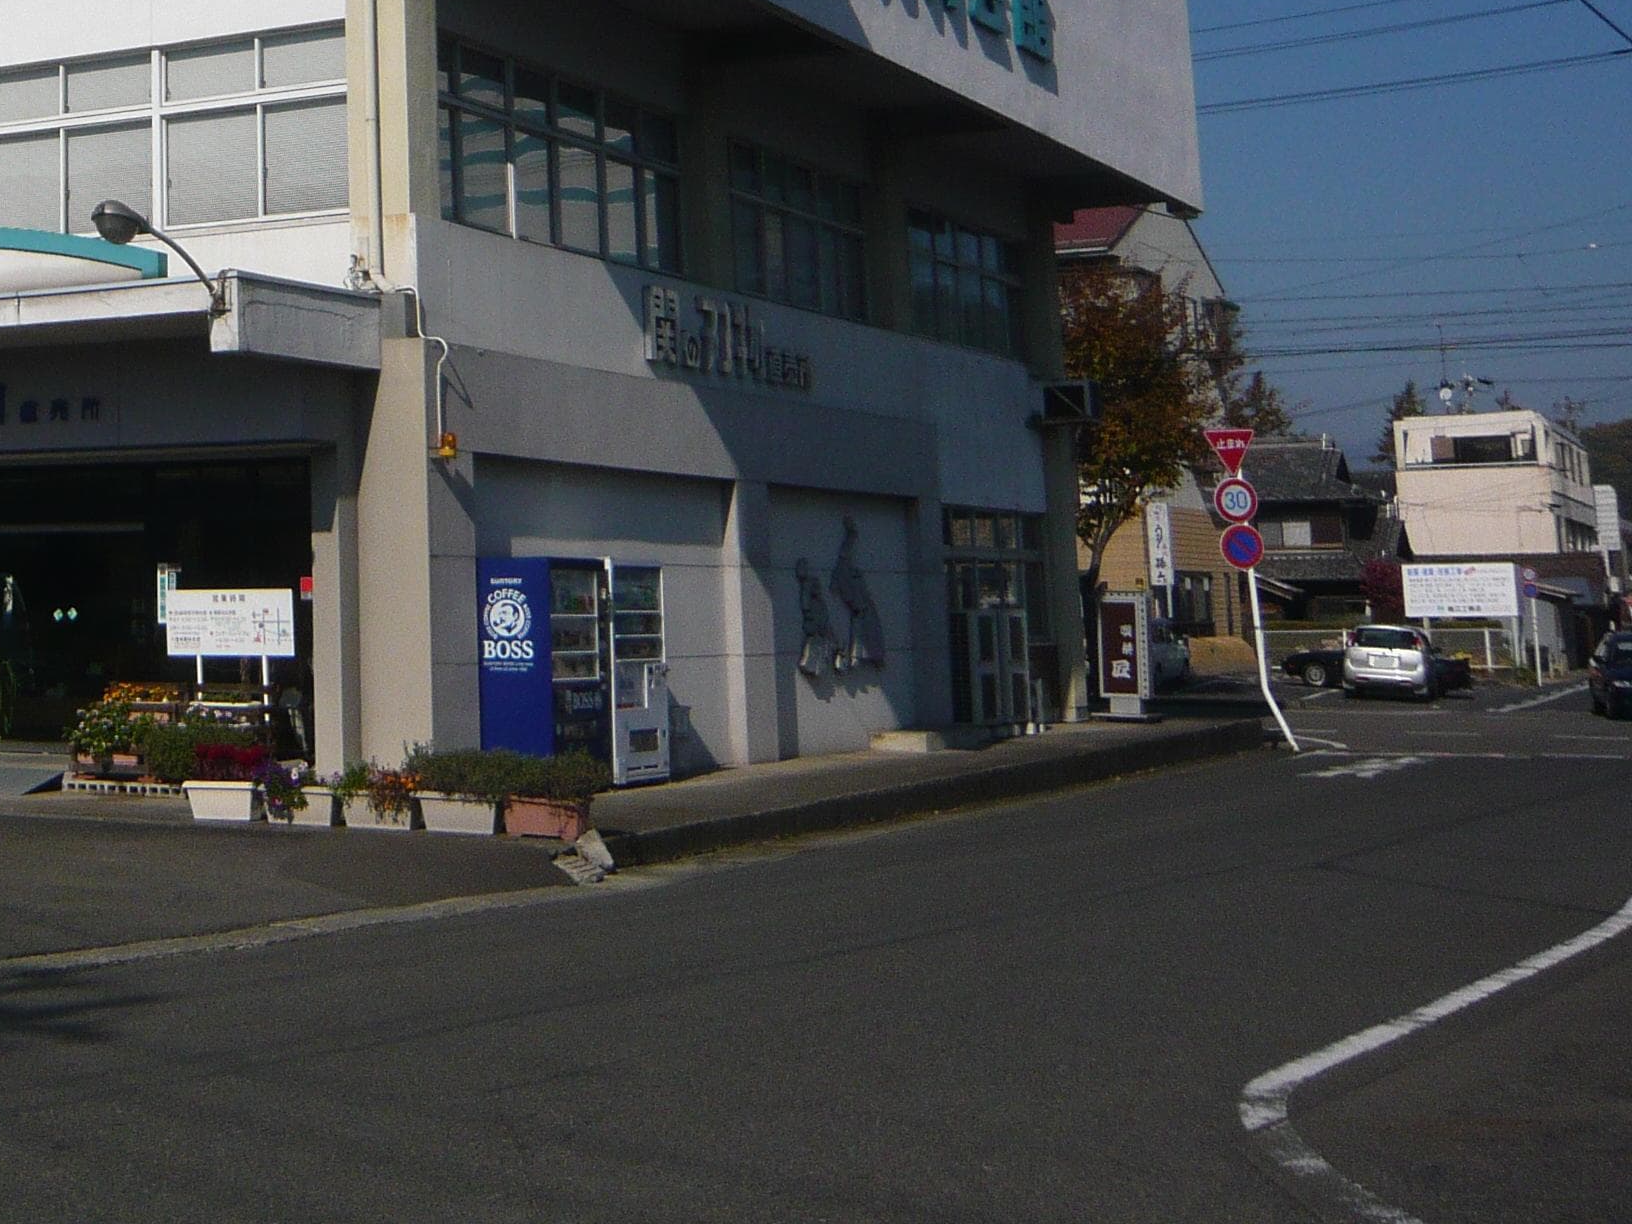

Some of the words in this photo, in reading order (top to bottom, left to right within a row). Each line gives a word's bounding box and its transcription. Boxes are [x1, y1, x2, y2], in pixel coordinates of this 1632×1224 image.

[1216, 438, 1246, 450] 止まれ
[1224, 490, 1248, 511] 30
[487, 587, 527, 604] COFFEE
[483, 640, 534, 660] BOSS
